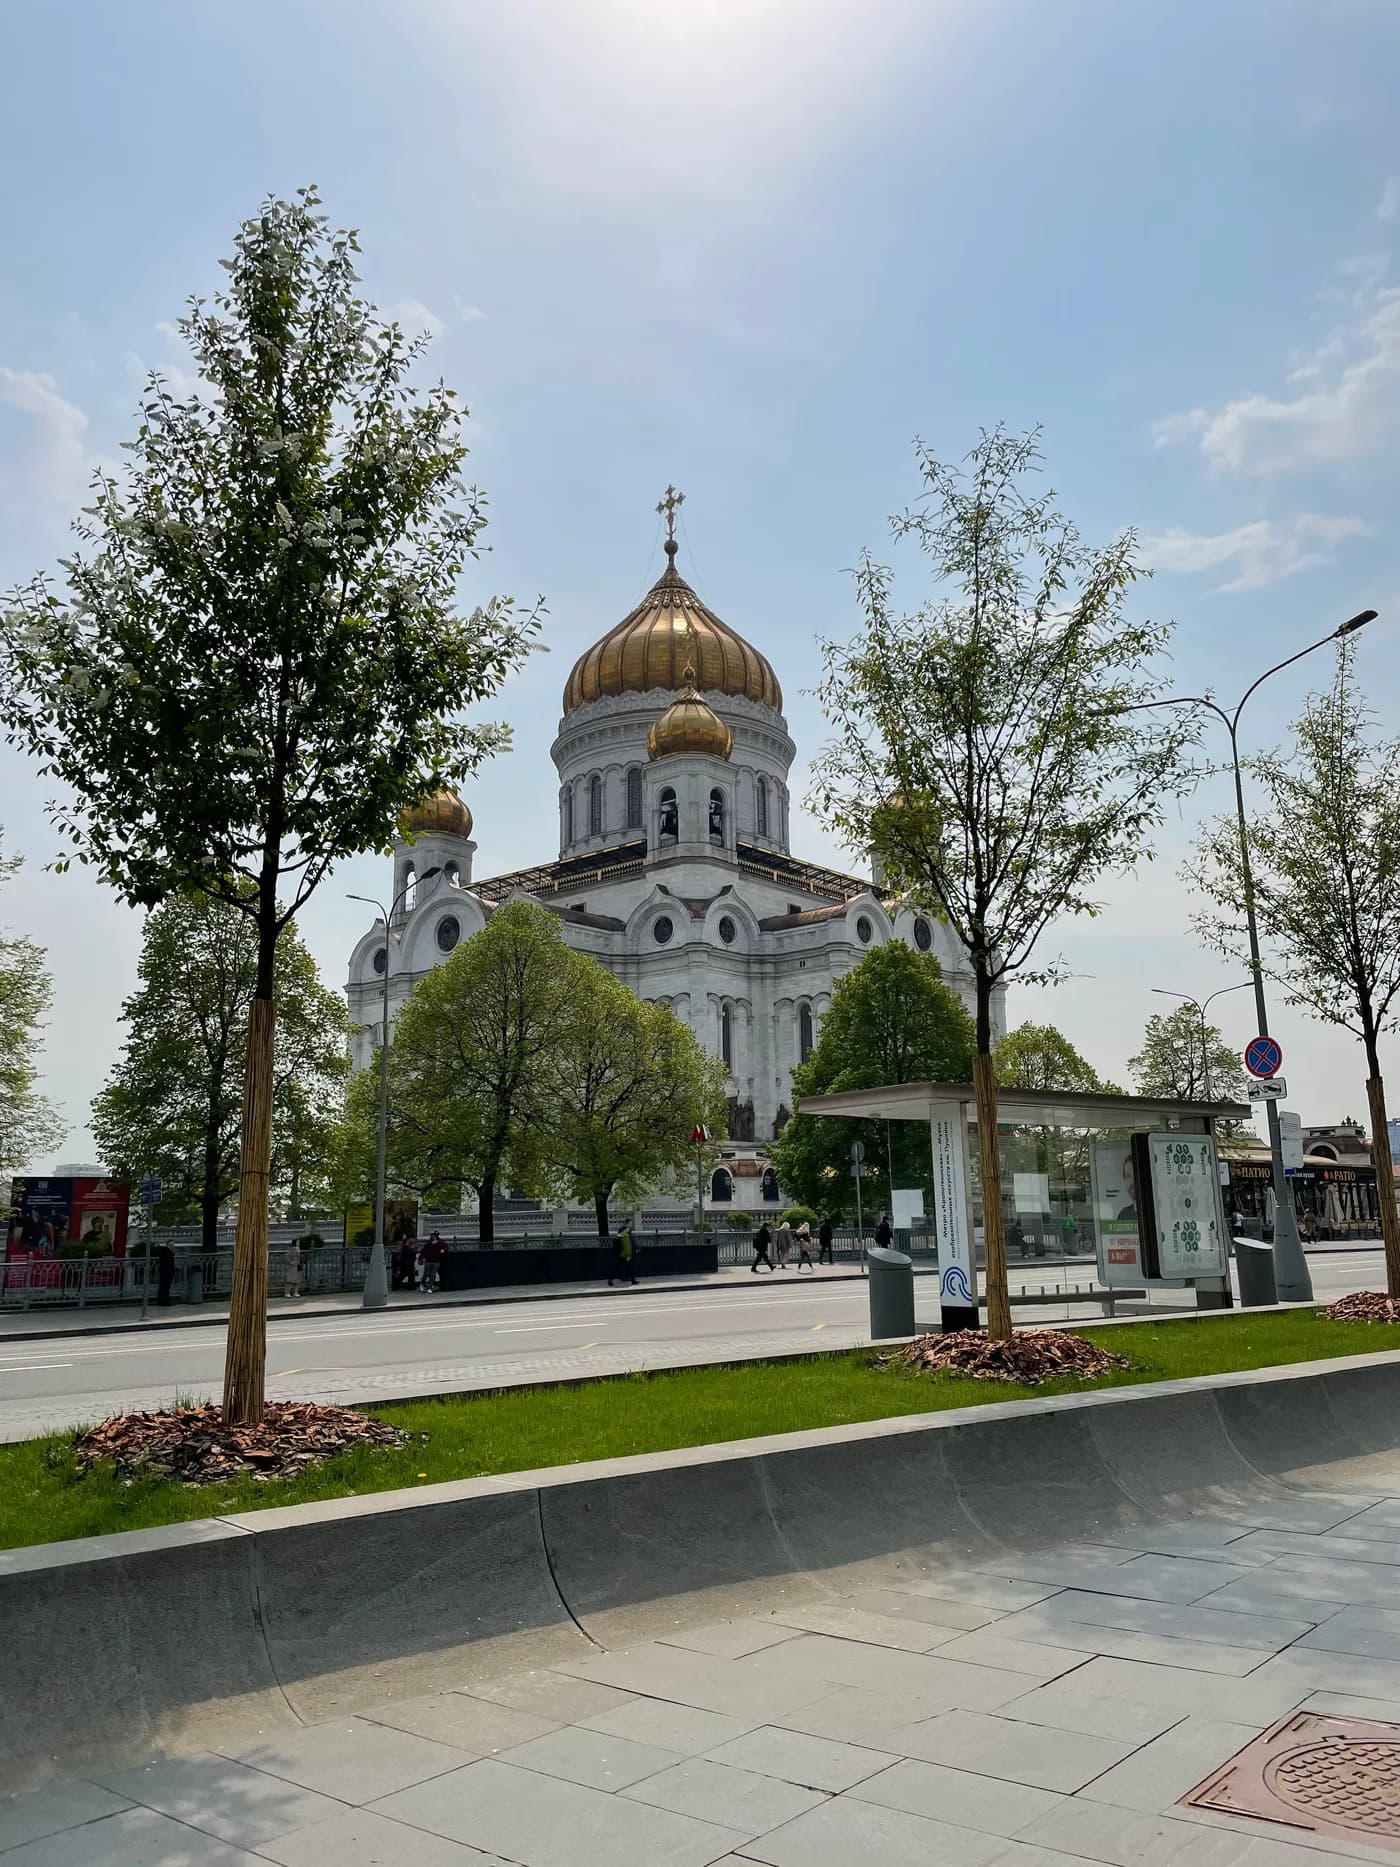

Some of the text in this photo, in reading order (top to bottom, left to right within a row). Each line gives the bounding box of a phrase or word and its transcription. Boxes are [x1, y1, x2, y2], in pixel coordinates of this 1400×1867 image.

[1241, 1167, 1271, 1179] ПАТИО
[1334, 1170, 1356, 1181] PATIO
[948, 1198, 956, 1259] изобразительных
